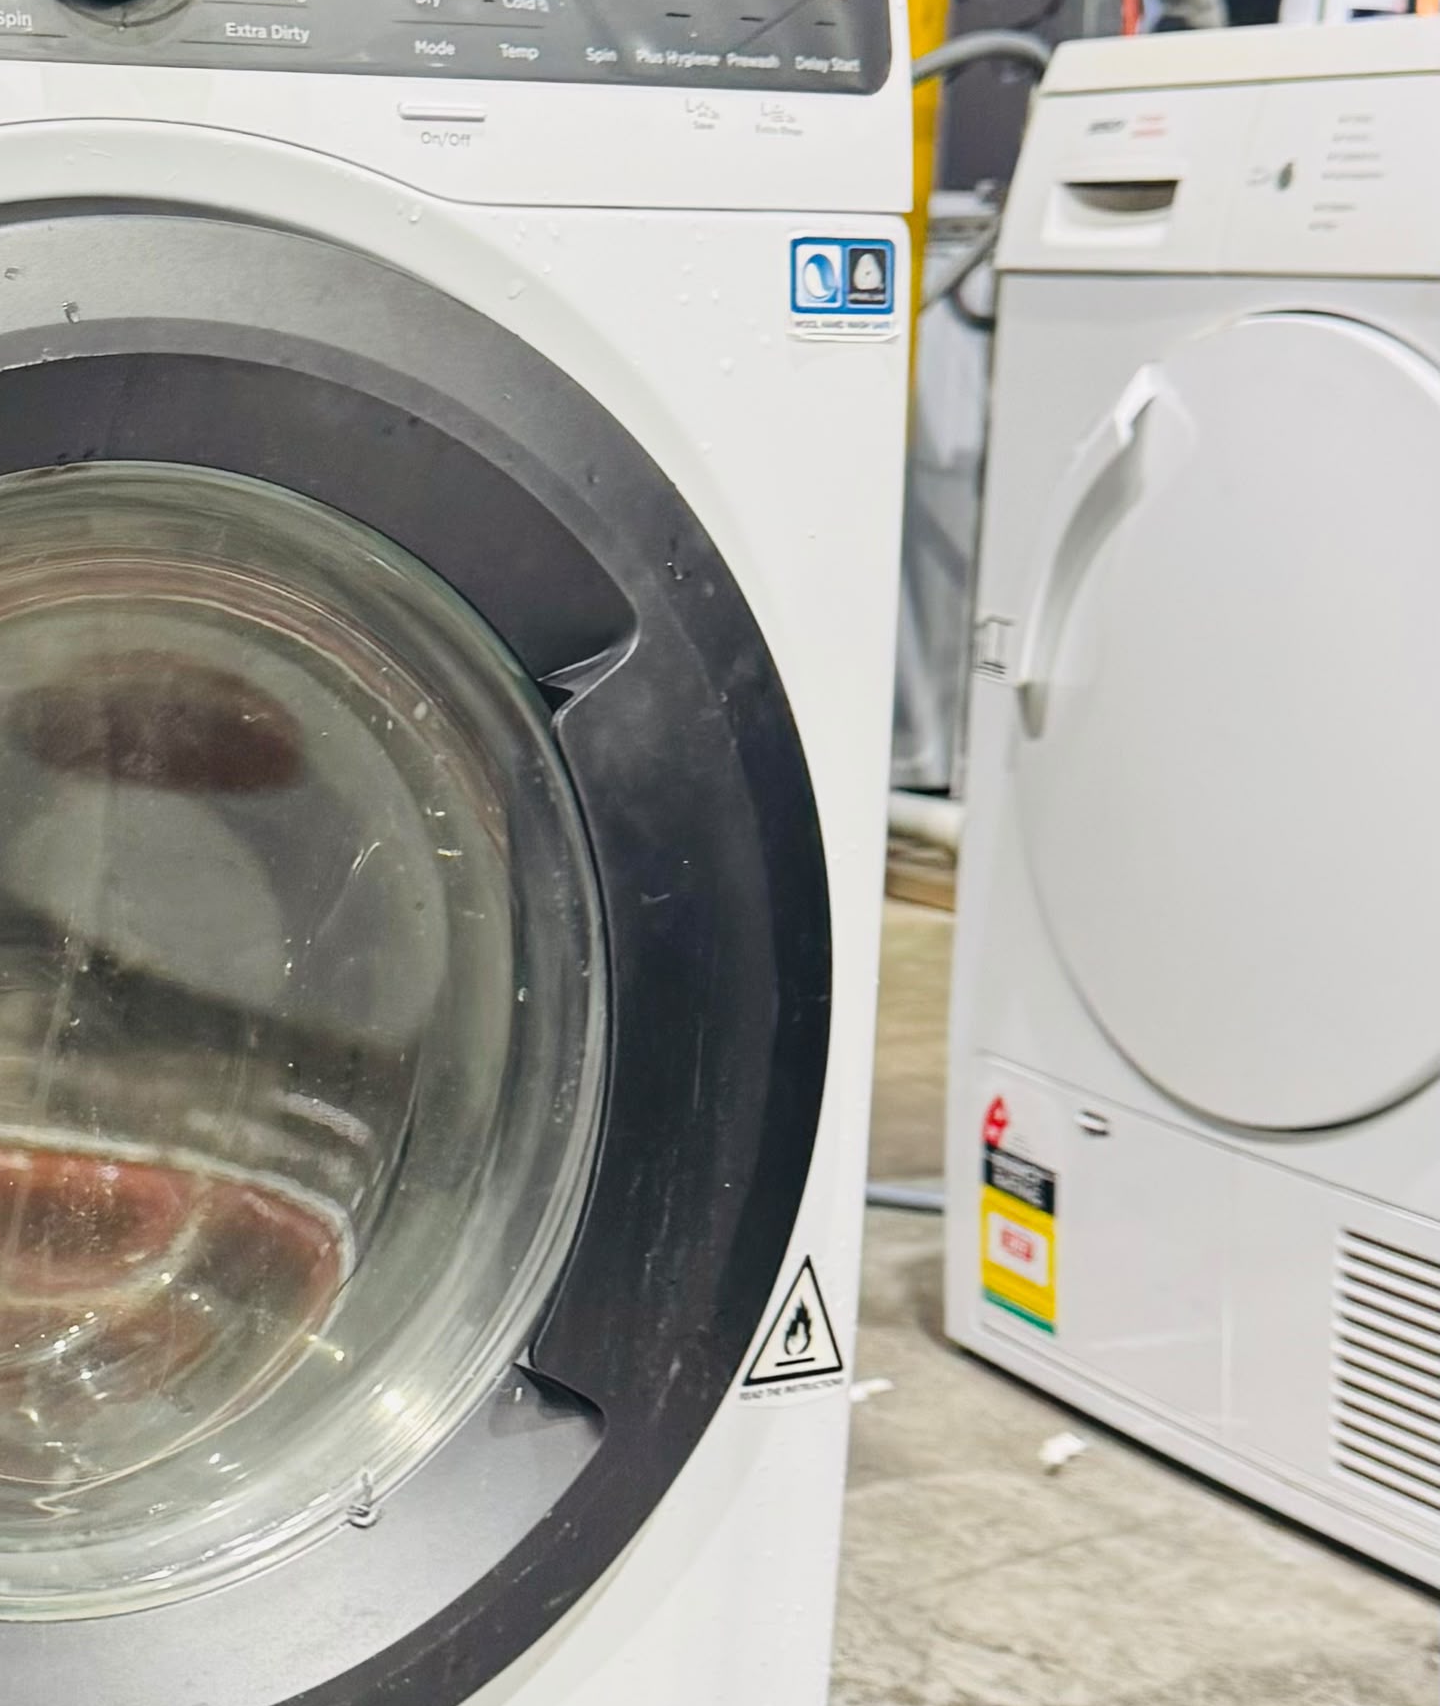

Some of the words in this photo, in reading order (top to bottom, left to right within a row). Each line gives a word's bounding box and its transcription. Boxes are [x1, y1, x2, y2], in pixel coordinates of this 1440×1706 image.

[225, 22, 268, 39] Extra
[271, 23, 310, 44] Dirty
[414, 39, 456, 56] Mode
[498, 42, 540, 61] Temp
[585, 46, 618, 64] Spin
[420, 130, 471, 148] On/Off
